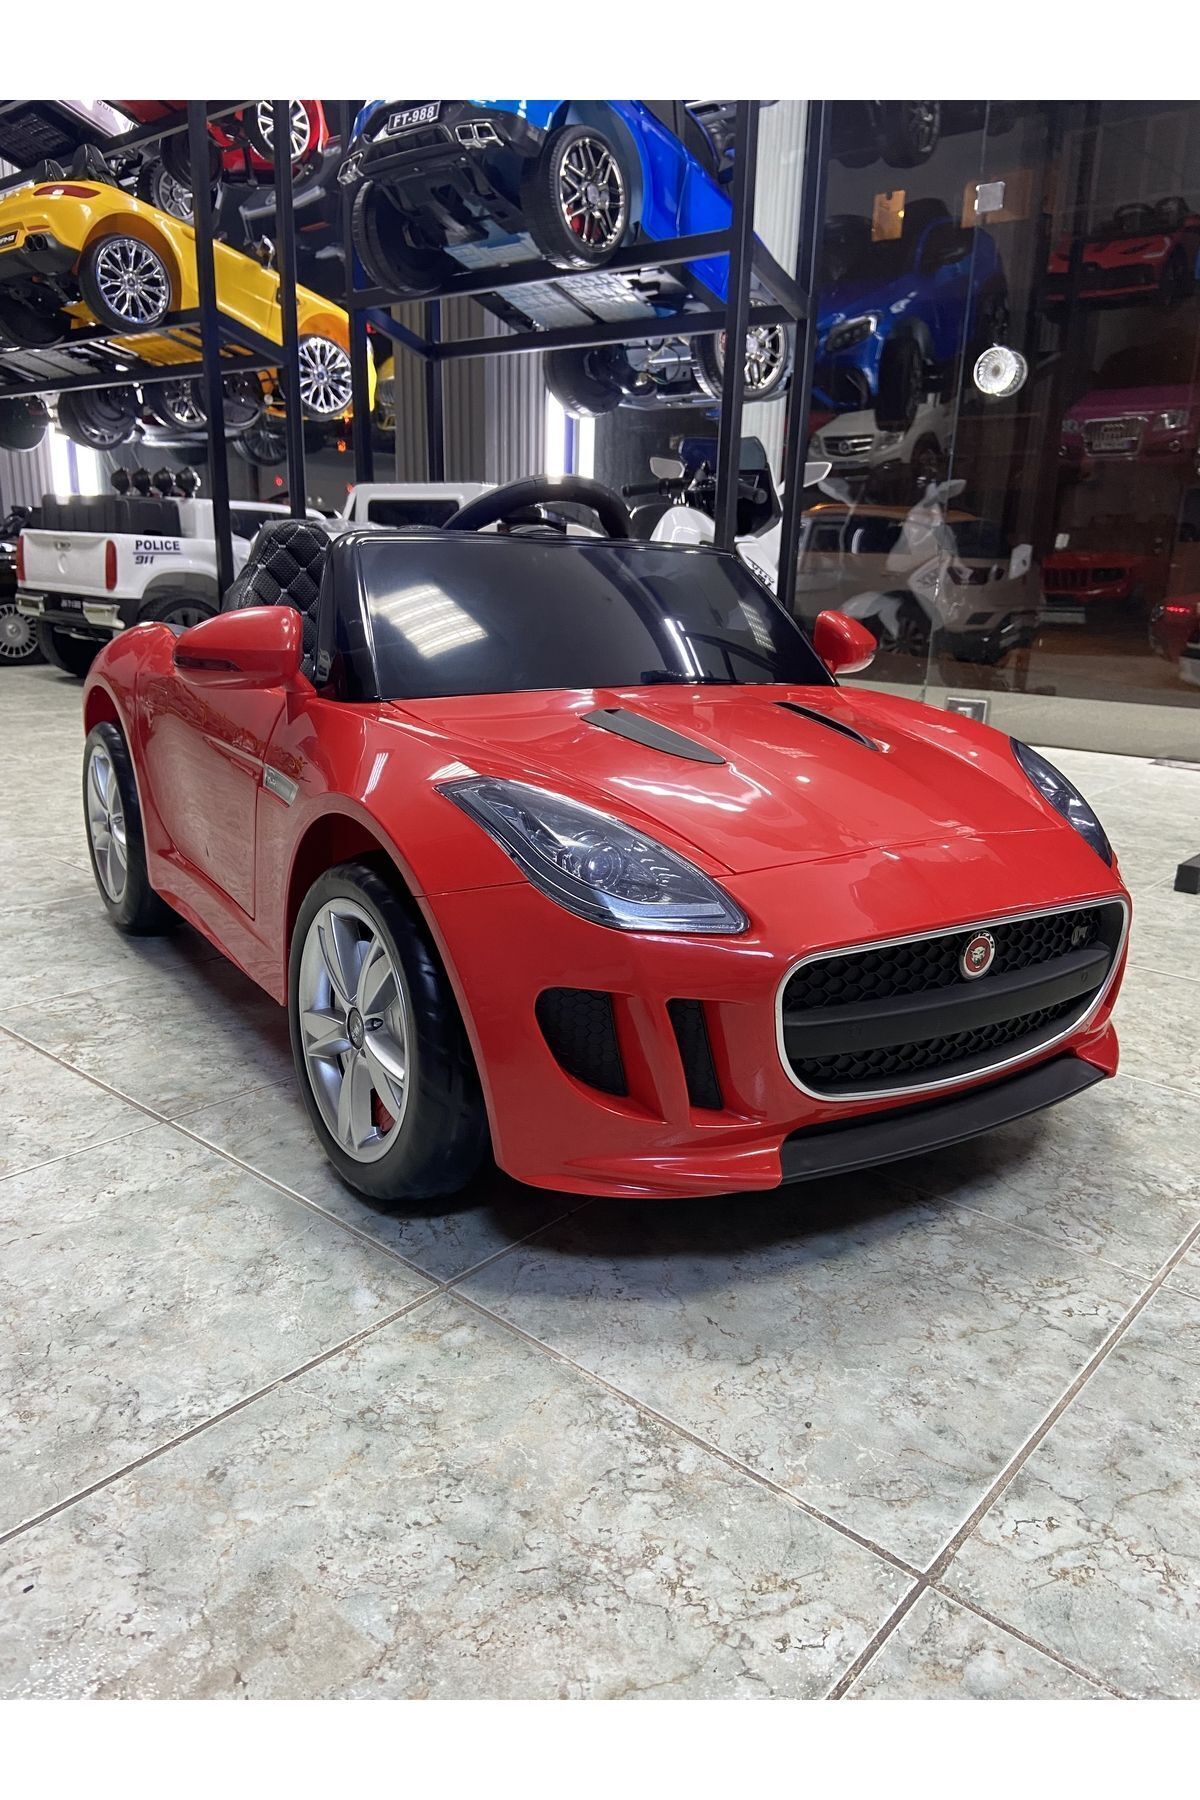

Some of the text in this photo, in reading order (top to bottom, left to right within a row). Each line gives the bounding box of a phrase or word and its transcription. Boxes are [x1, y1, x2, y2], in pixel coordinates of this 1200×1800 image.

[393, 105, 435, 126] FT-988
[135, 540, 180, 550] POLICE
[134, 555, 155, 565] 911
